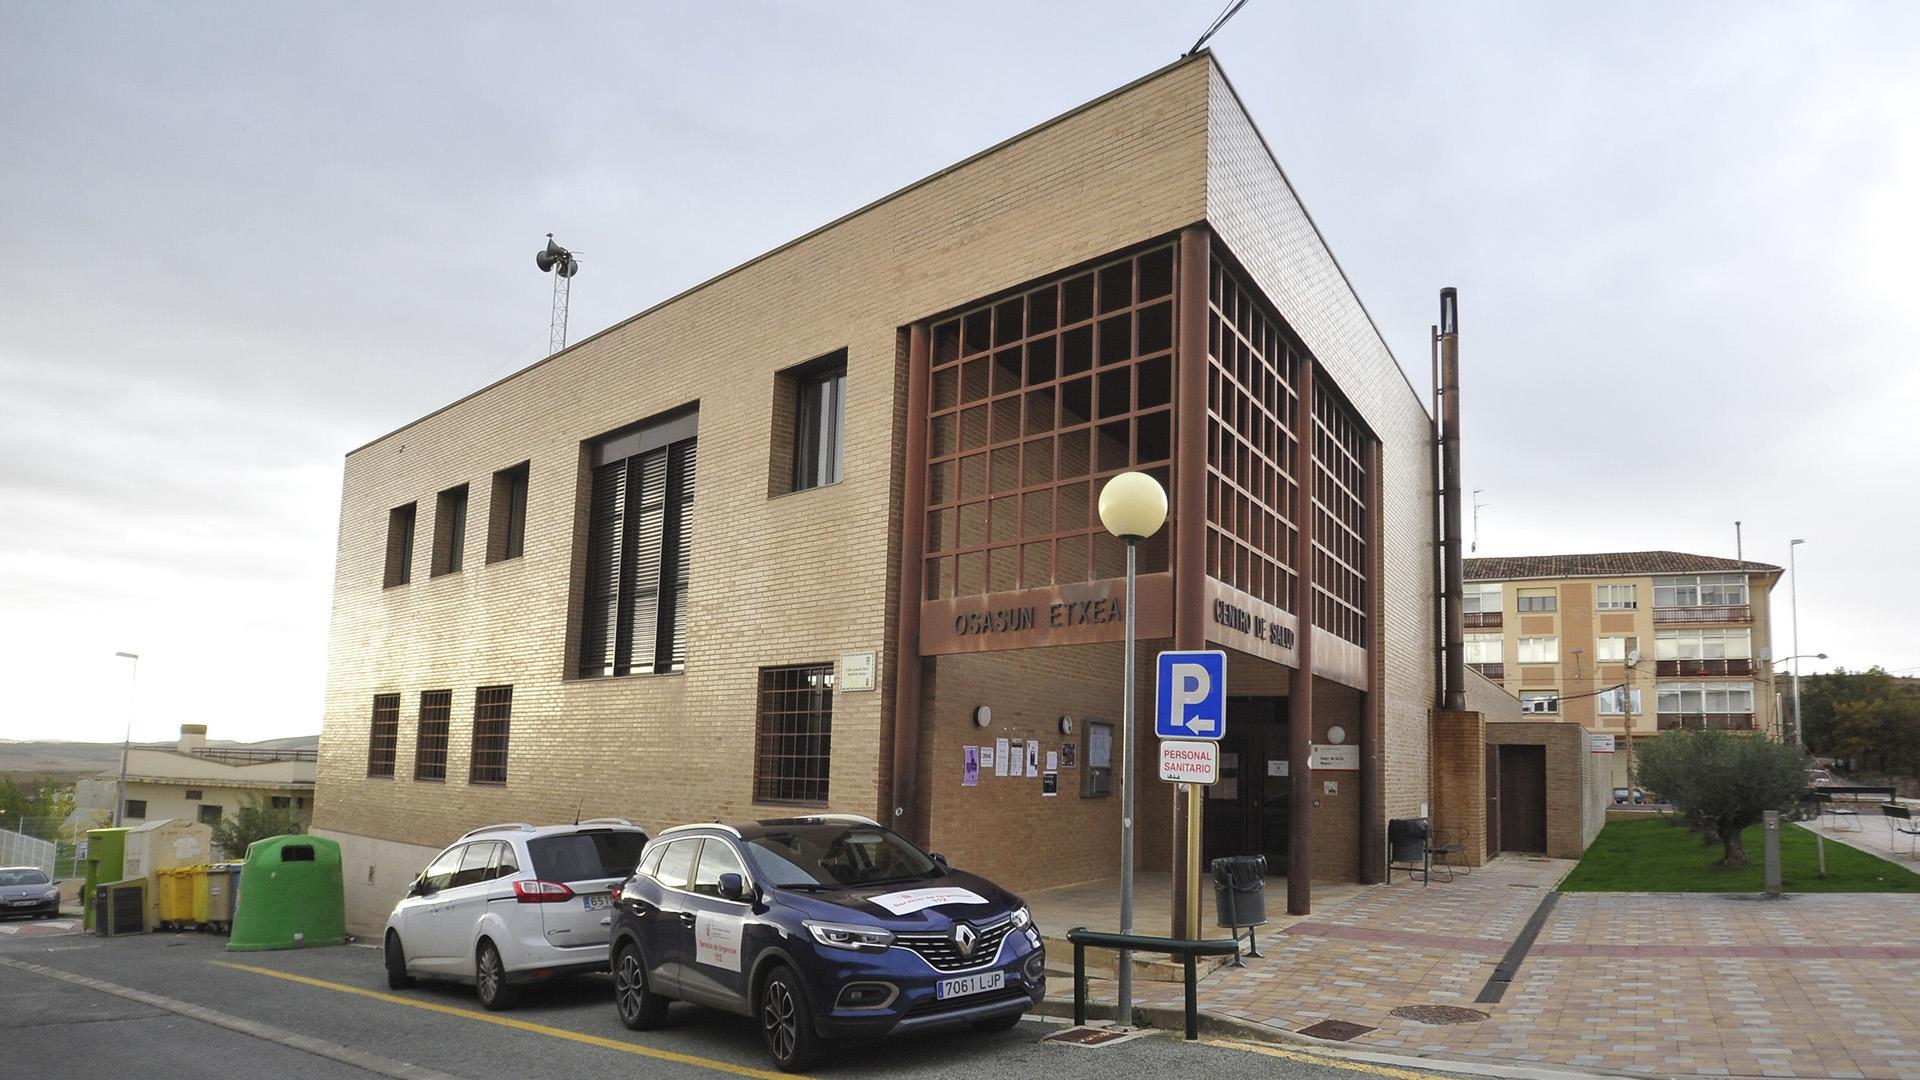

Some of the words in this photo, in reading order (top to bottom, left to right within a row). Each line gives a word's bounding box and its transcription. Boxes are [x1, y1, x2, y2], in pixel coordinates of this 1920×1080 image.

[955, 606, 1035, 636] OSASUN
[1049, 598, 1122, 627] ETXEA
[1214, 598, 1252, 634] CENTRO
[1254, 615, 1266, 640] DE
[1270, 621, 1295, 650] SALUD
[1170, 663, 1211, 727] P
[1164, 749, 1212, 761] PERSONAL
[1164, 761, 1211, 774] SANITARIO
[945, 978, 975, 996] 7061
[980, 973, 1001, 990] LJP
